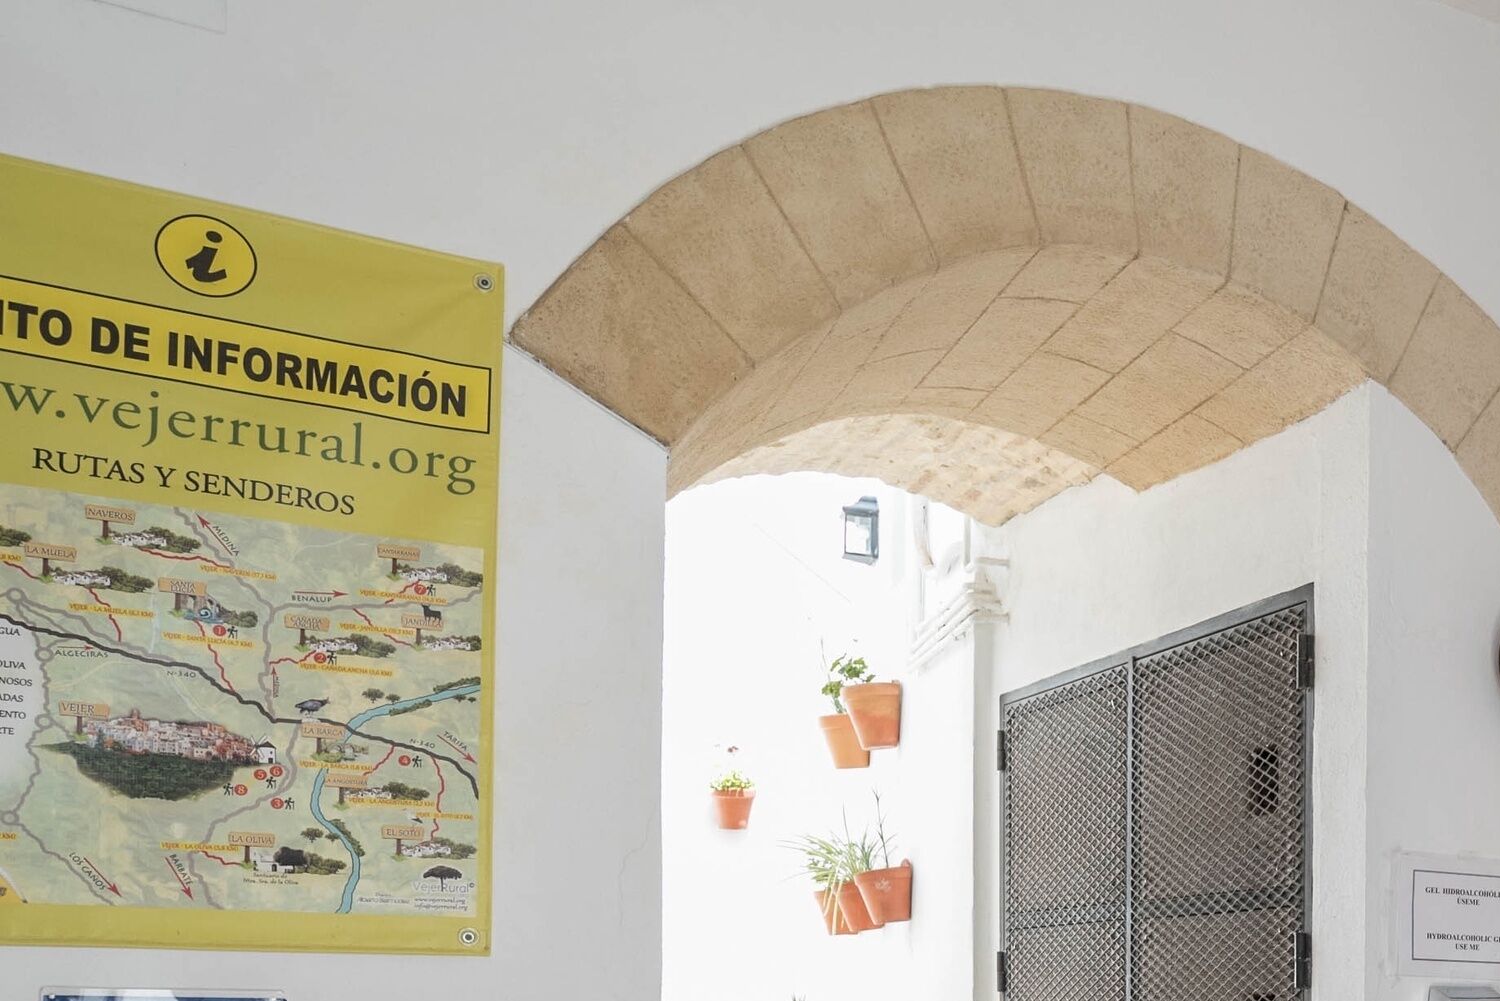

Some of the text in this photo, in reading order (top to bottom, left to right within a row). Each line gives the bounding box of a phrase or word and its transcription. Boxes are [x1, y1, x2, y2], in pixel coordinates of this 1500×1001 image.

[0, 299, 466, 418] TO DE INFORMACIÓN
[32, 448, 356, 516] RUTAS Y SENDEROS
[88, 508, 133, 521] NAVEROS
[212, 525, 240, 557] MEDINA
[61, 701, 95, 714] VEJER
[245, 835, 274, 845] OLIVA
[69, 851, 85, 866] LOS
[169, 853, 194, 886] BARBATE
[1425, 886, 1440, 894] GEL
[1426, 932, 1492, 943] HYDROALCOHOLIC
[1455, 943, 1468, 951] USE
